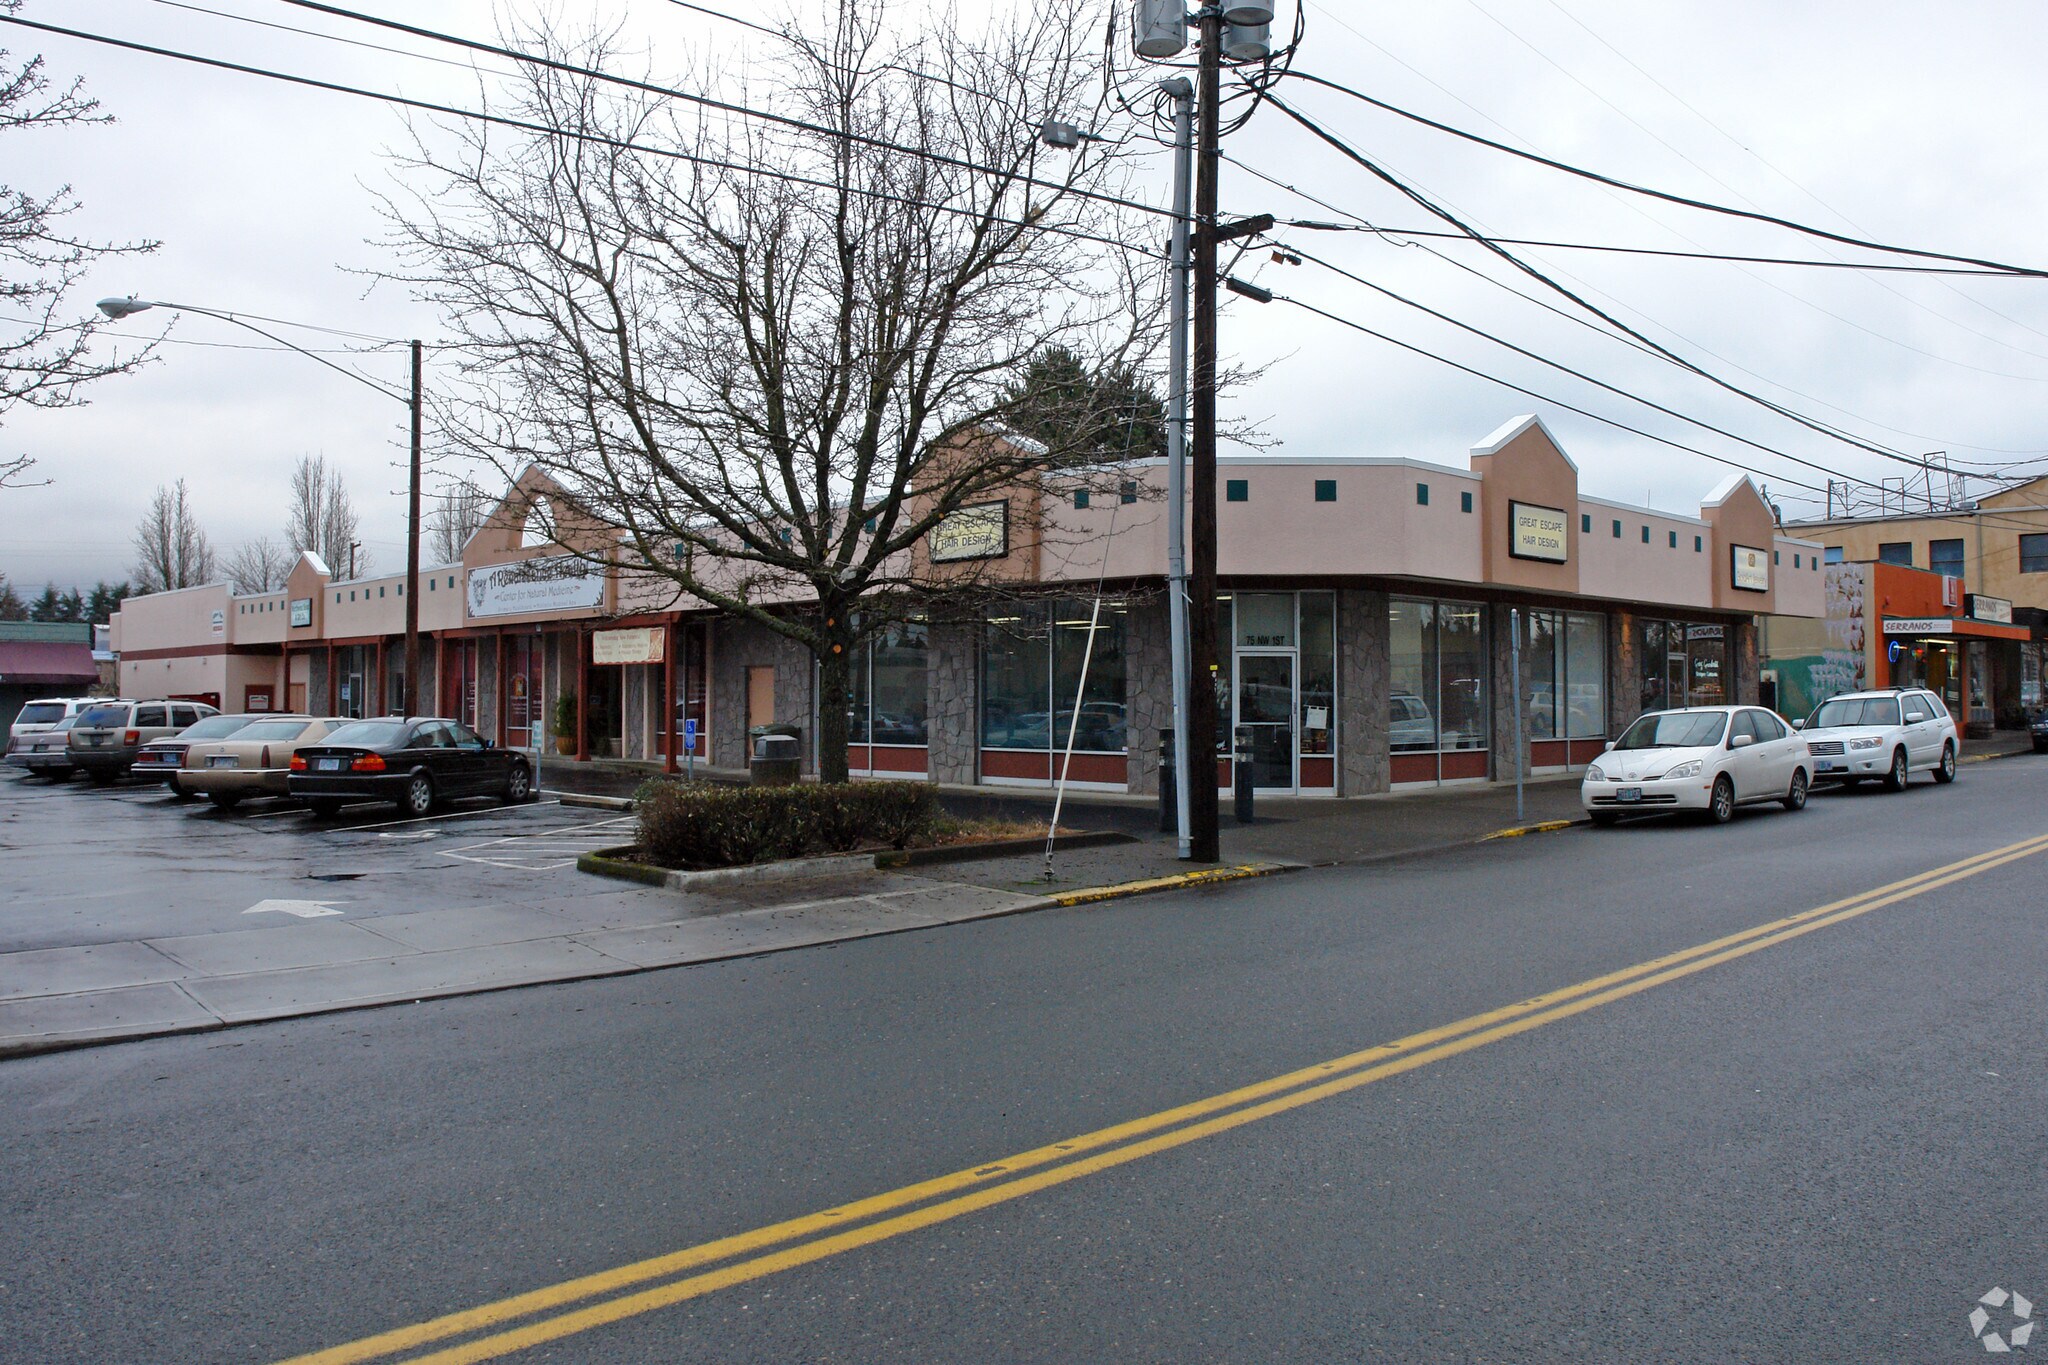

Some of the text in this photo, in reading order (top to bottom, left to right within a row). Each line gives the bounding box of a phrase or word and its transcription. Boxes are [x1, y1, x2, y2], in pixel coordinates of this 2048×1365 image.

[1519, 516, 1563, 532] GREAT ESCAPE
[942, 534, 992, 549] HAIR DESIGN
[1522, 534, 1560, 549] HAIR DESIGN
[518, 590, 526, 601] for
[527, 587, 547, 599] Natural
[548, 585, 574, 597] Medicine
[1885, 622, 1933, 631] SERRANOS
[1246, 635, 1285, 646] 75 NW 1ST
